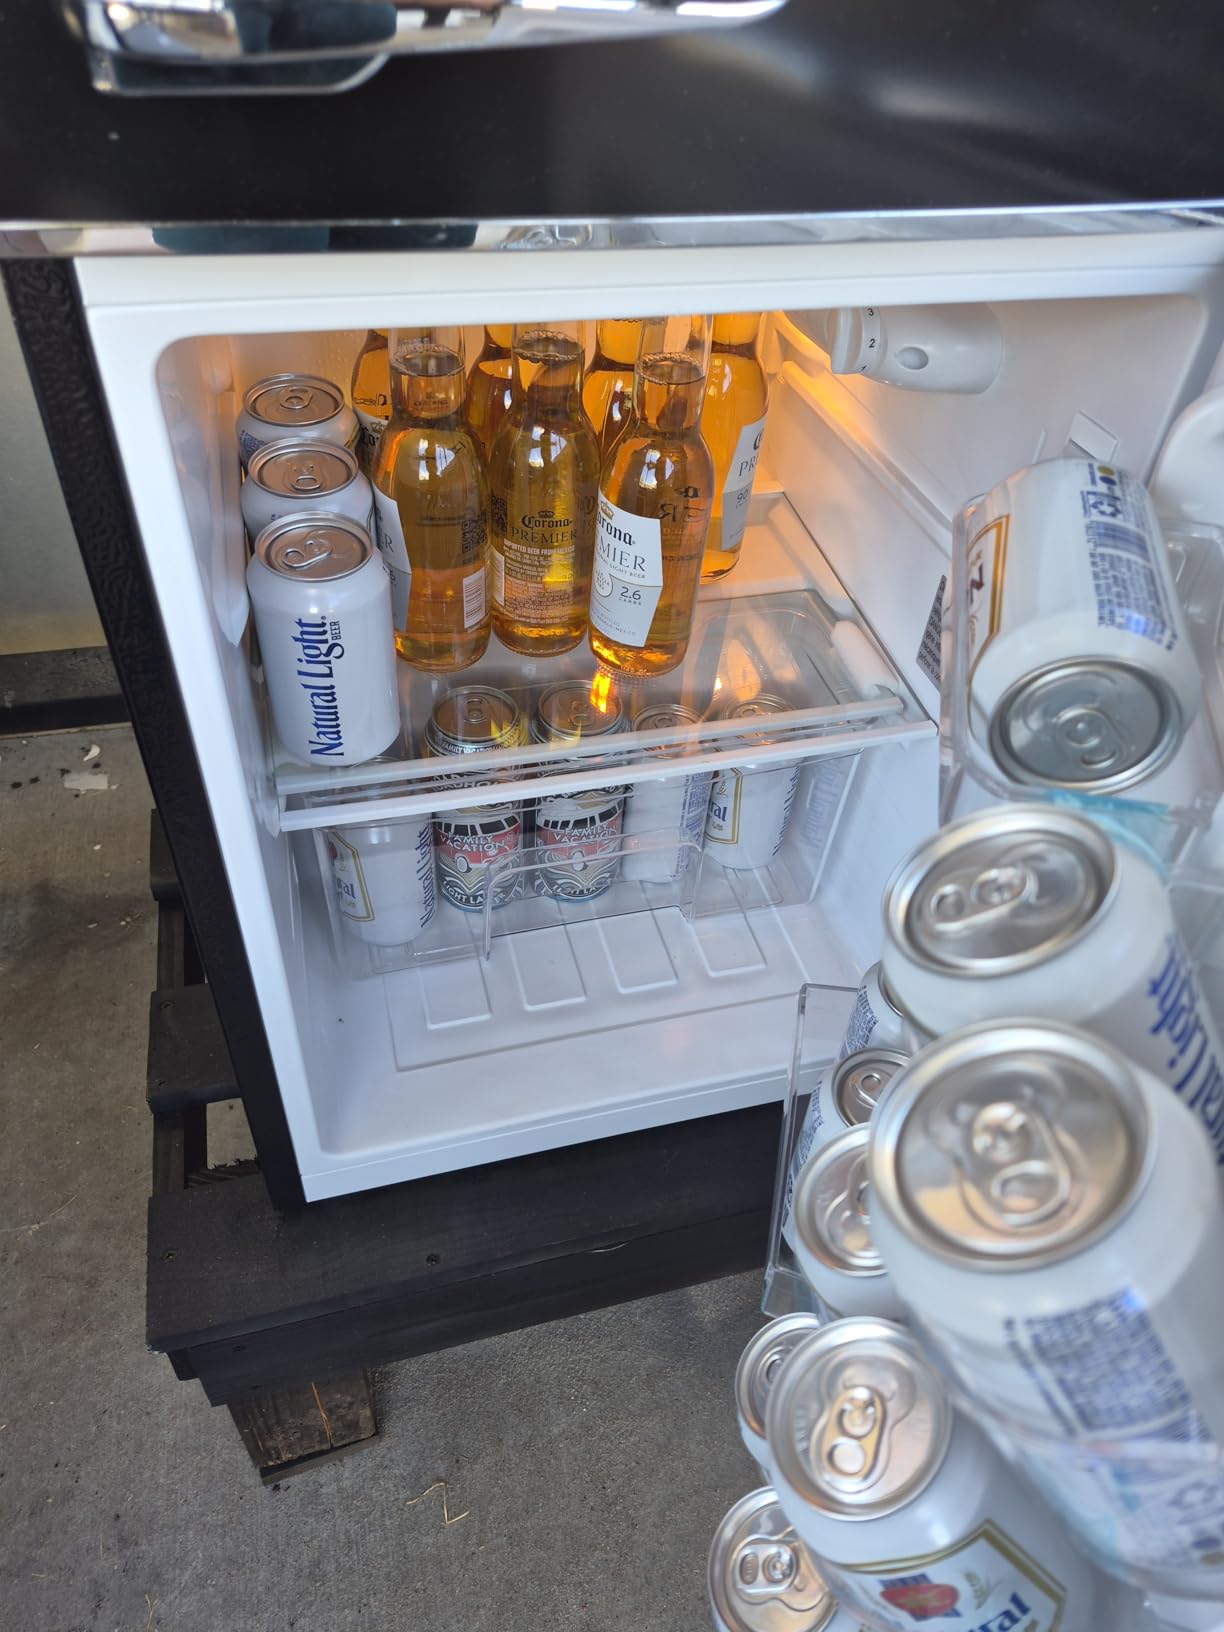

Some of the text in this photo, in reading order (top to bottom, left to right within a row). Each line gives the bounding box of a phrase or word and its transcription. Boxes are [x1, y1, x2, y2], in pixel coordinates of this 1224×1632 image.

[867, 307, 874, 317] 3
[868, 338, 876, 348] 2
[521, 514, 569, 529] Corona
[597, 511, 632, 546] orona
[511, 527, 577, 544] PREMIER
[600, 535, 646, 572] MIER
[620, 586, 641, 600] 2.6
[329, 620, 342, 641] BEER
[291, 617, 345, 757] Natural Light
[565, 822, 609, 836] FAMILY
[439, 834, 507, 852] VACATION
[448, 832, 494, 845] FAMILY
[443, 880, 507, 904] LIGHT LAER
